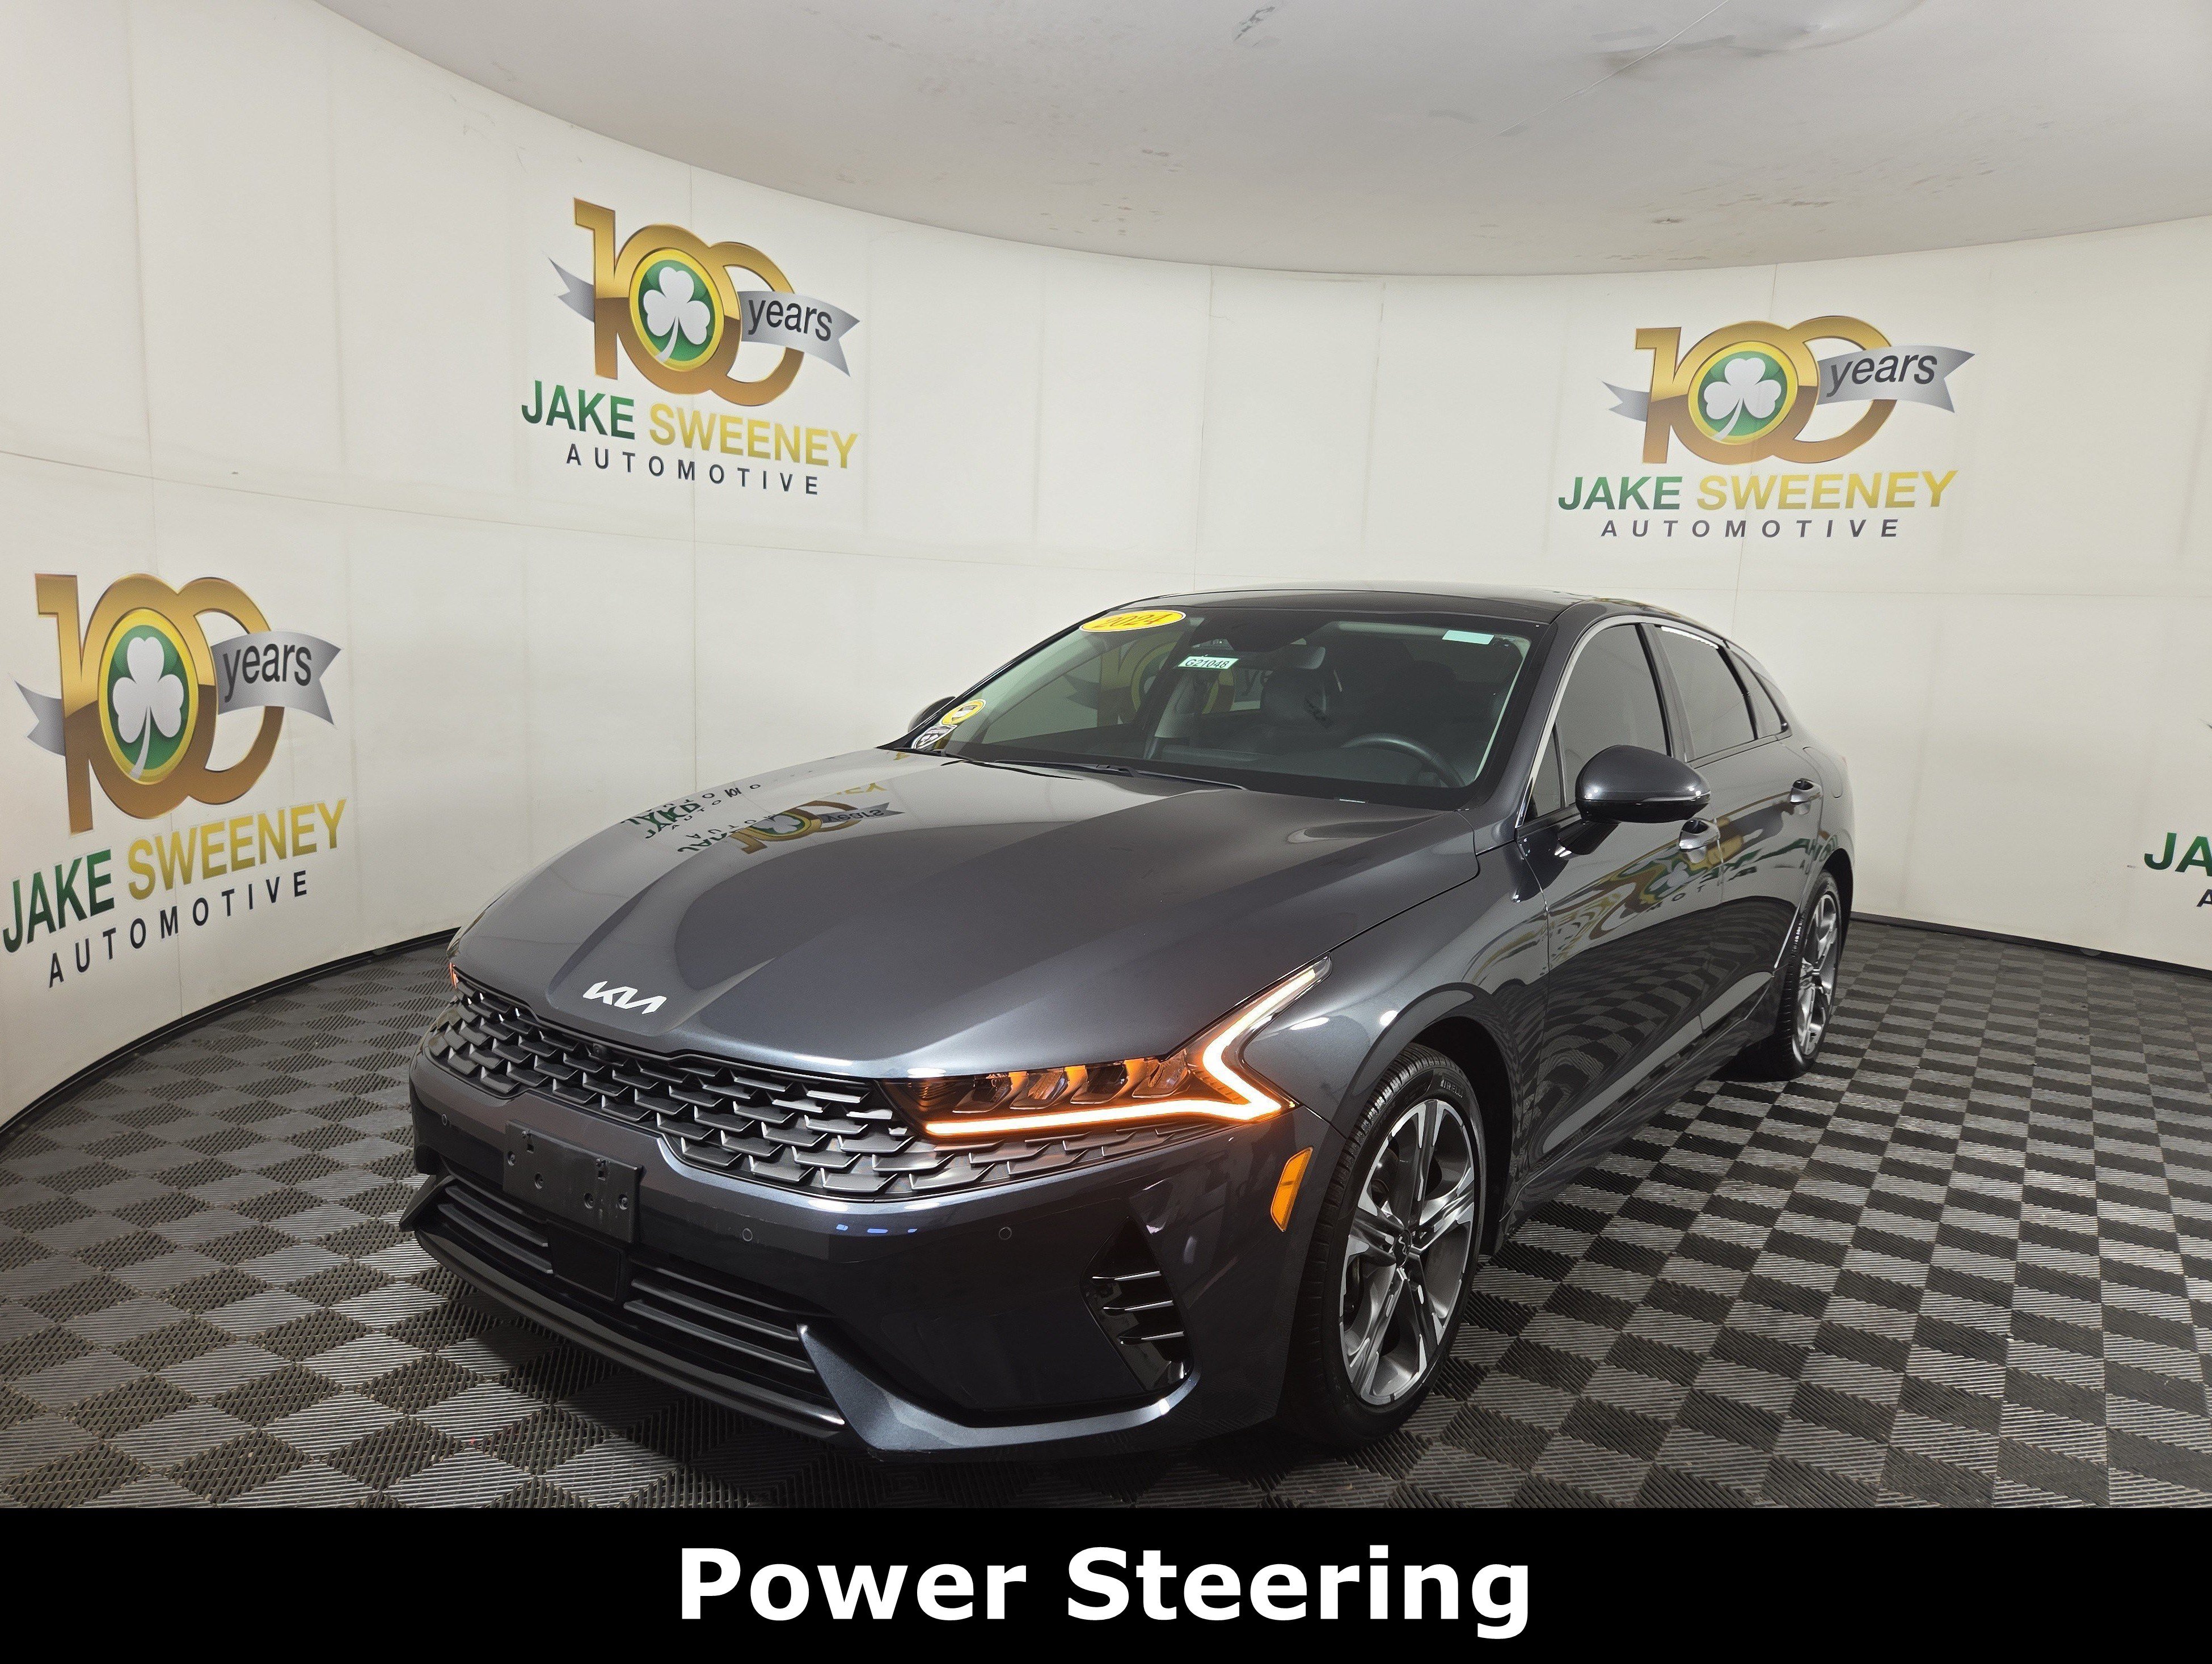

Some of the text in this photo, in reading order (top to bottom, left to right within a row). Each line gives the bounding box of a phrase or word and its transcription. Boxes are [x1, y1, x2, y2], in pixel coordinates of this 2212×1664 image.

[573, 197, 833, 407] 100 years
[521, 379, 859, 469] JAKE SWEENEY
[1634, 315, 1939, 465] 100 years
[565, 442, 819, 496] AUTOMOTIVE
[1557, 470, 1958, 511] JAKE SWEENEY
[1600, 518, 1899, 539] AUTOMOTIVE
[1091, 613, 1173, 629] 2024
[1185, 658, 1230, 669] G21048
[34, 572, 313, 835] 100 years
[2, 799, 348, 953] JAKE SWEENEY
[48, 869, 307, 989] AUTOMOTIVE
[582, 980, 667, 1015] KIA
